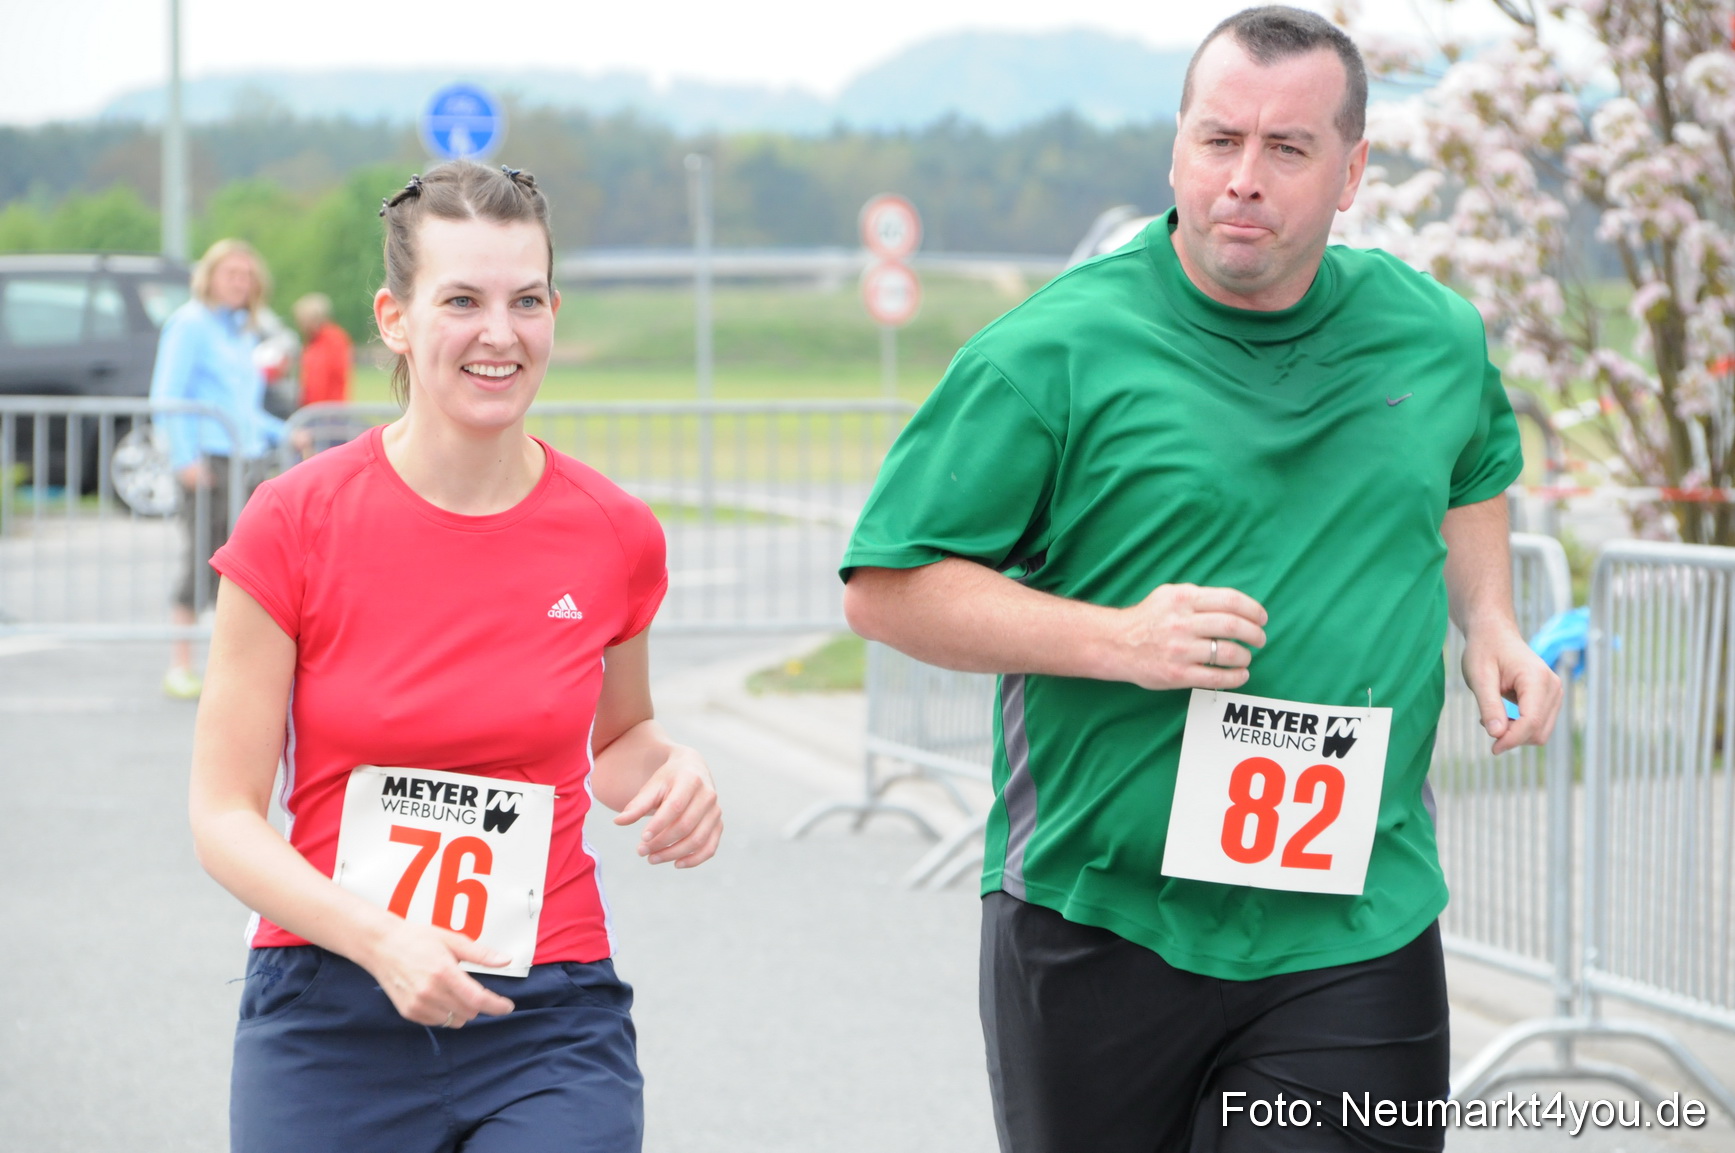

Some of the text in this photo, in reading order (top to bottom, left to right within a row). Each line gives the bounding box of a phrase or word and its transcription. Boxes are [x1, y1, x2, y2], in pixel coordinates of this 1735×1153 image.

[547, 608, 583, 620] adidas
[1222, 702, 1319, 735] MEYER
[1221, 724, 1317, 752] WERBUNG
[381, 776, 479, 808] MEYER
[381, 797, 477, 825] WERBUNG
[1220, 756, 1346, 871] 82
[386, 824, 494, 943] 76
